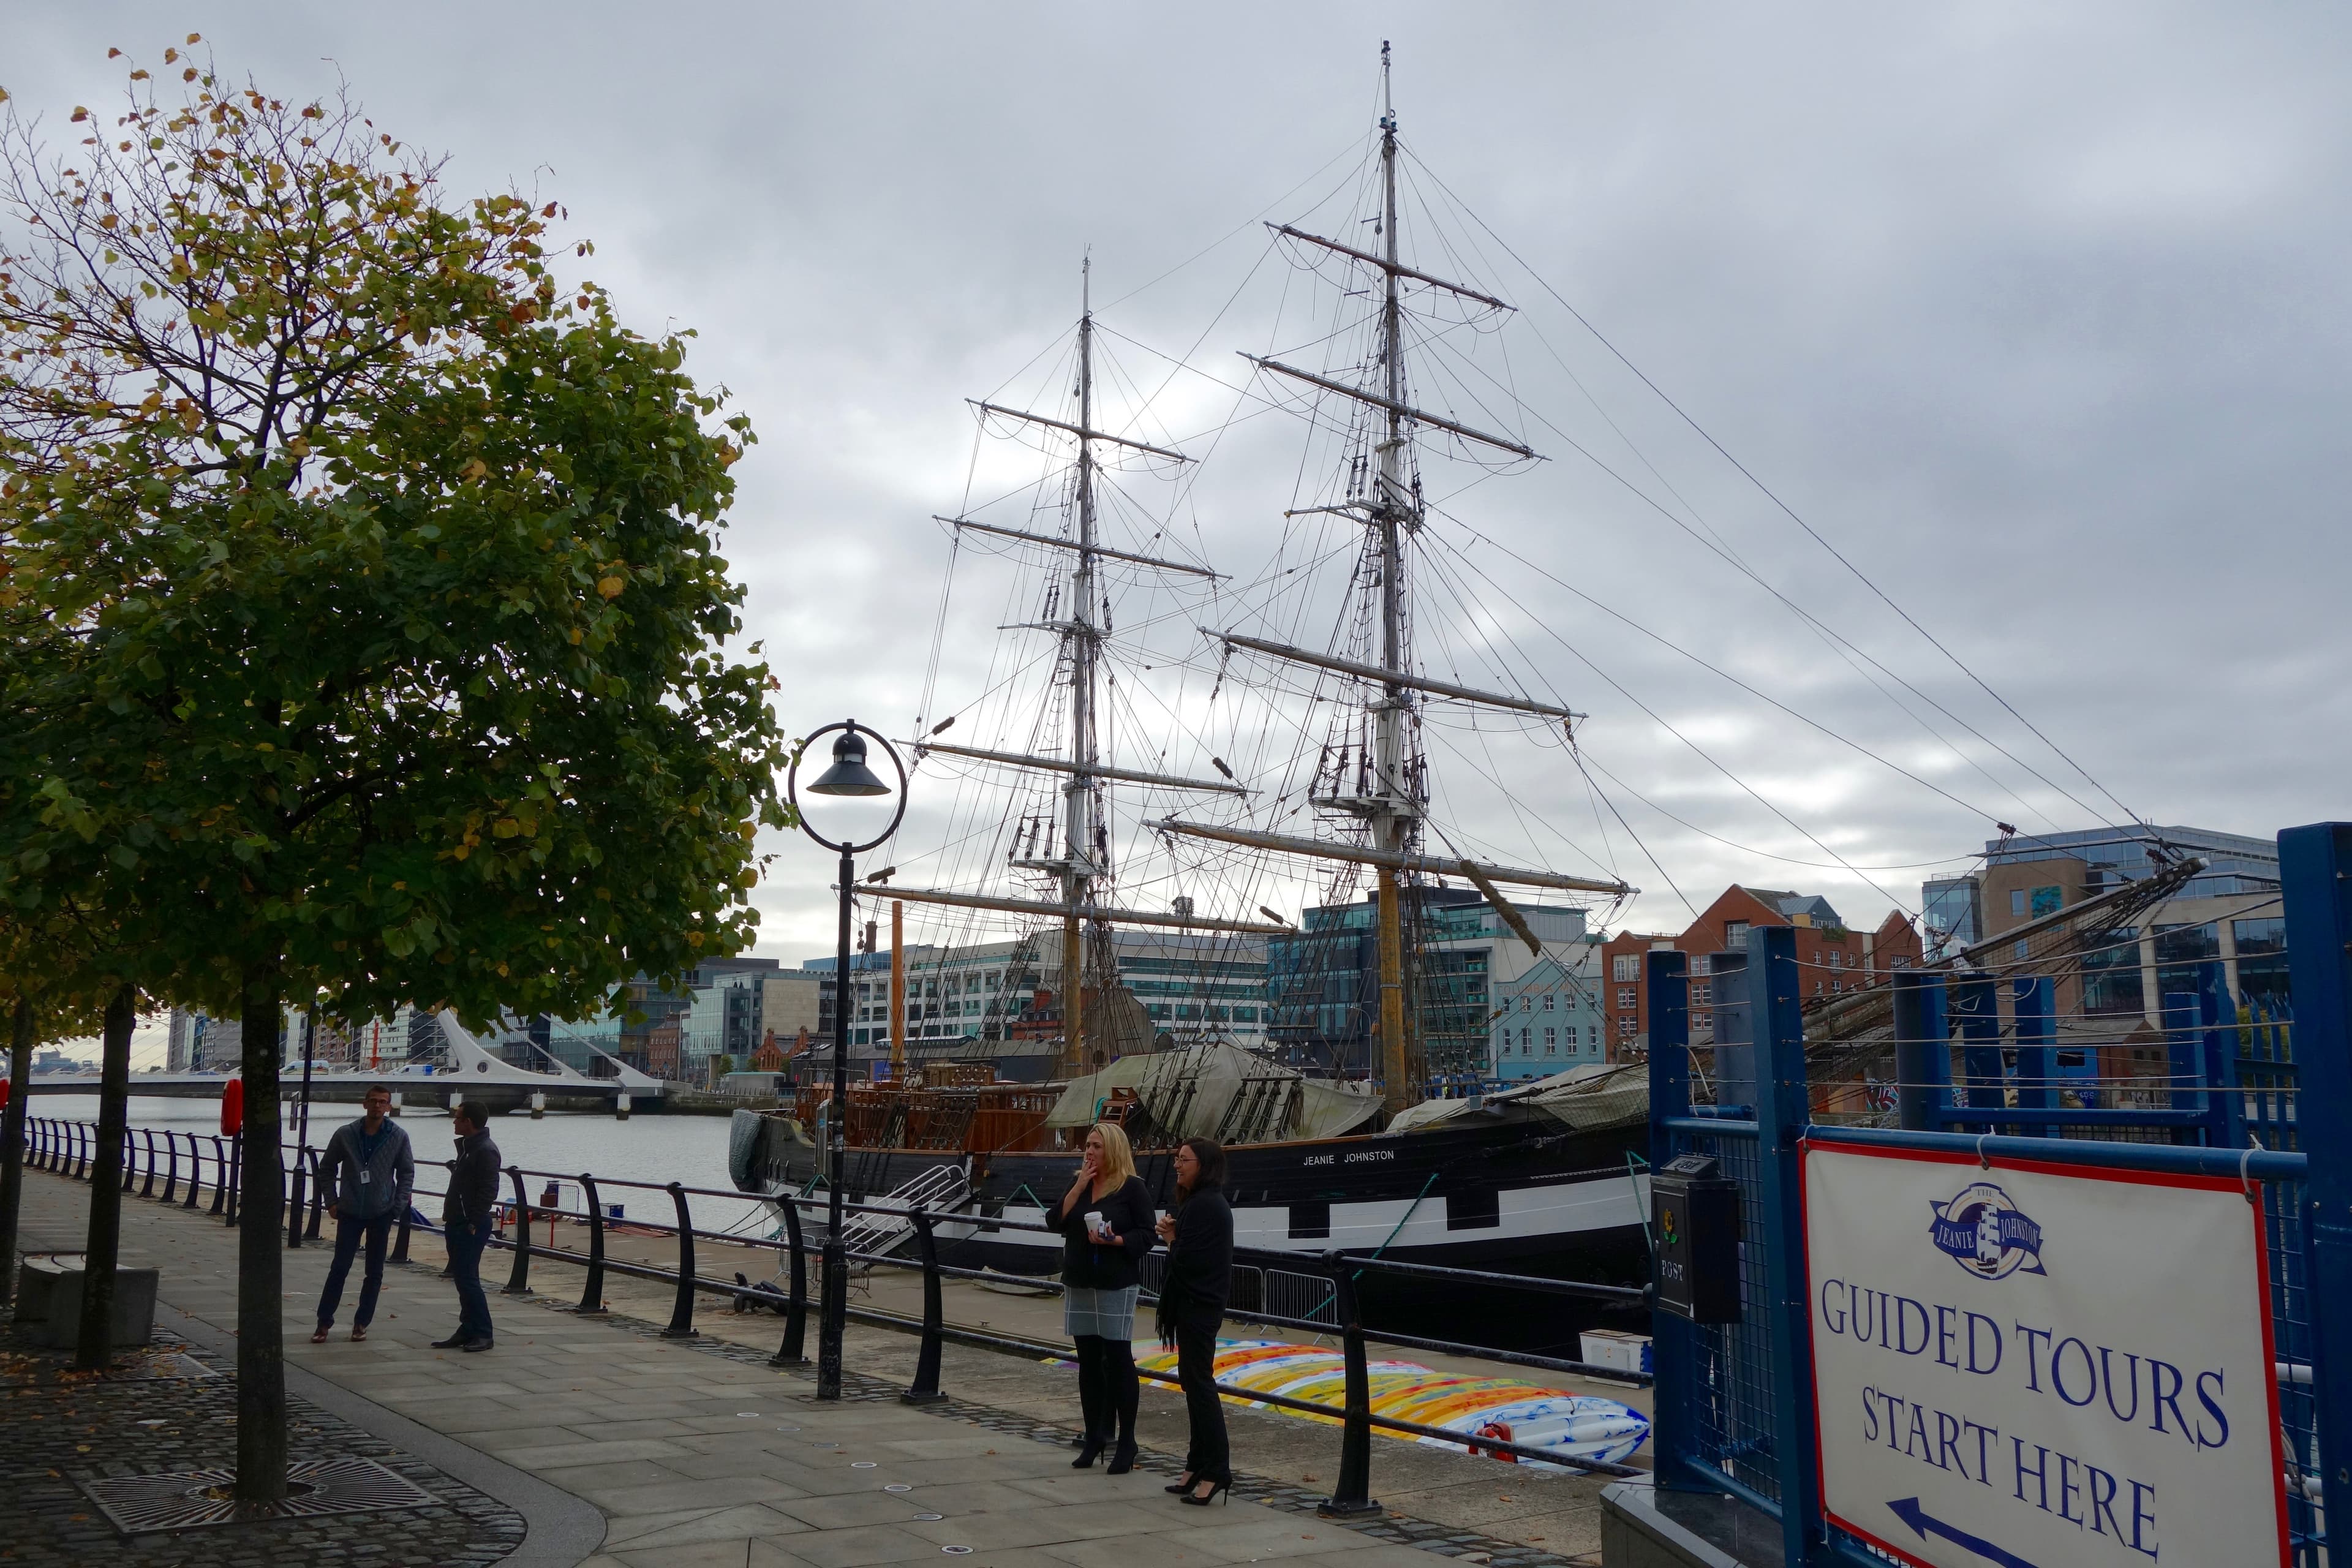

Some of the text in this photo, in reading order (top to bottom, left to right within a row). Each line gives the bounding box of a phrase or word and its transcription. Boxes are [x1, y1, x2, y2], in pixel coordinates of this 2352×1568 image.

[1498, 984, 1553, 995] COLUMBIA
[1303, 1150, 1394, 1166] JEANIE JOHNSTON
[1975, 1189, 1995, 1197] THE
[1936, 1218, 2039, 1249] JEANIE JOHNSTON
[1662, 1259, 1683, 1281] POST
[1822, 1277, 2230, 1452] GUIDED TOURS
[1862, 1384, 2160, 1564] START HERE
